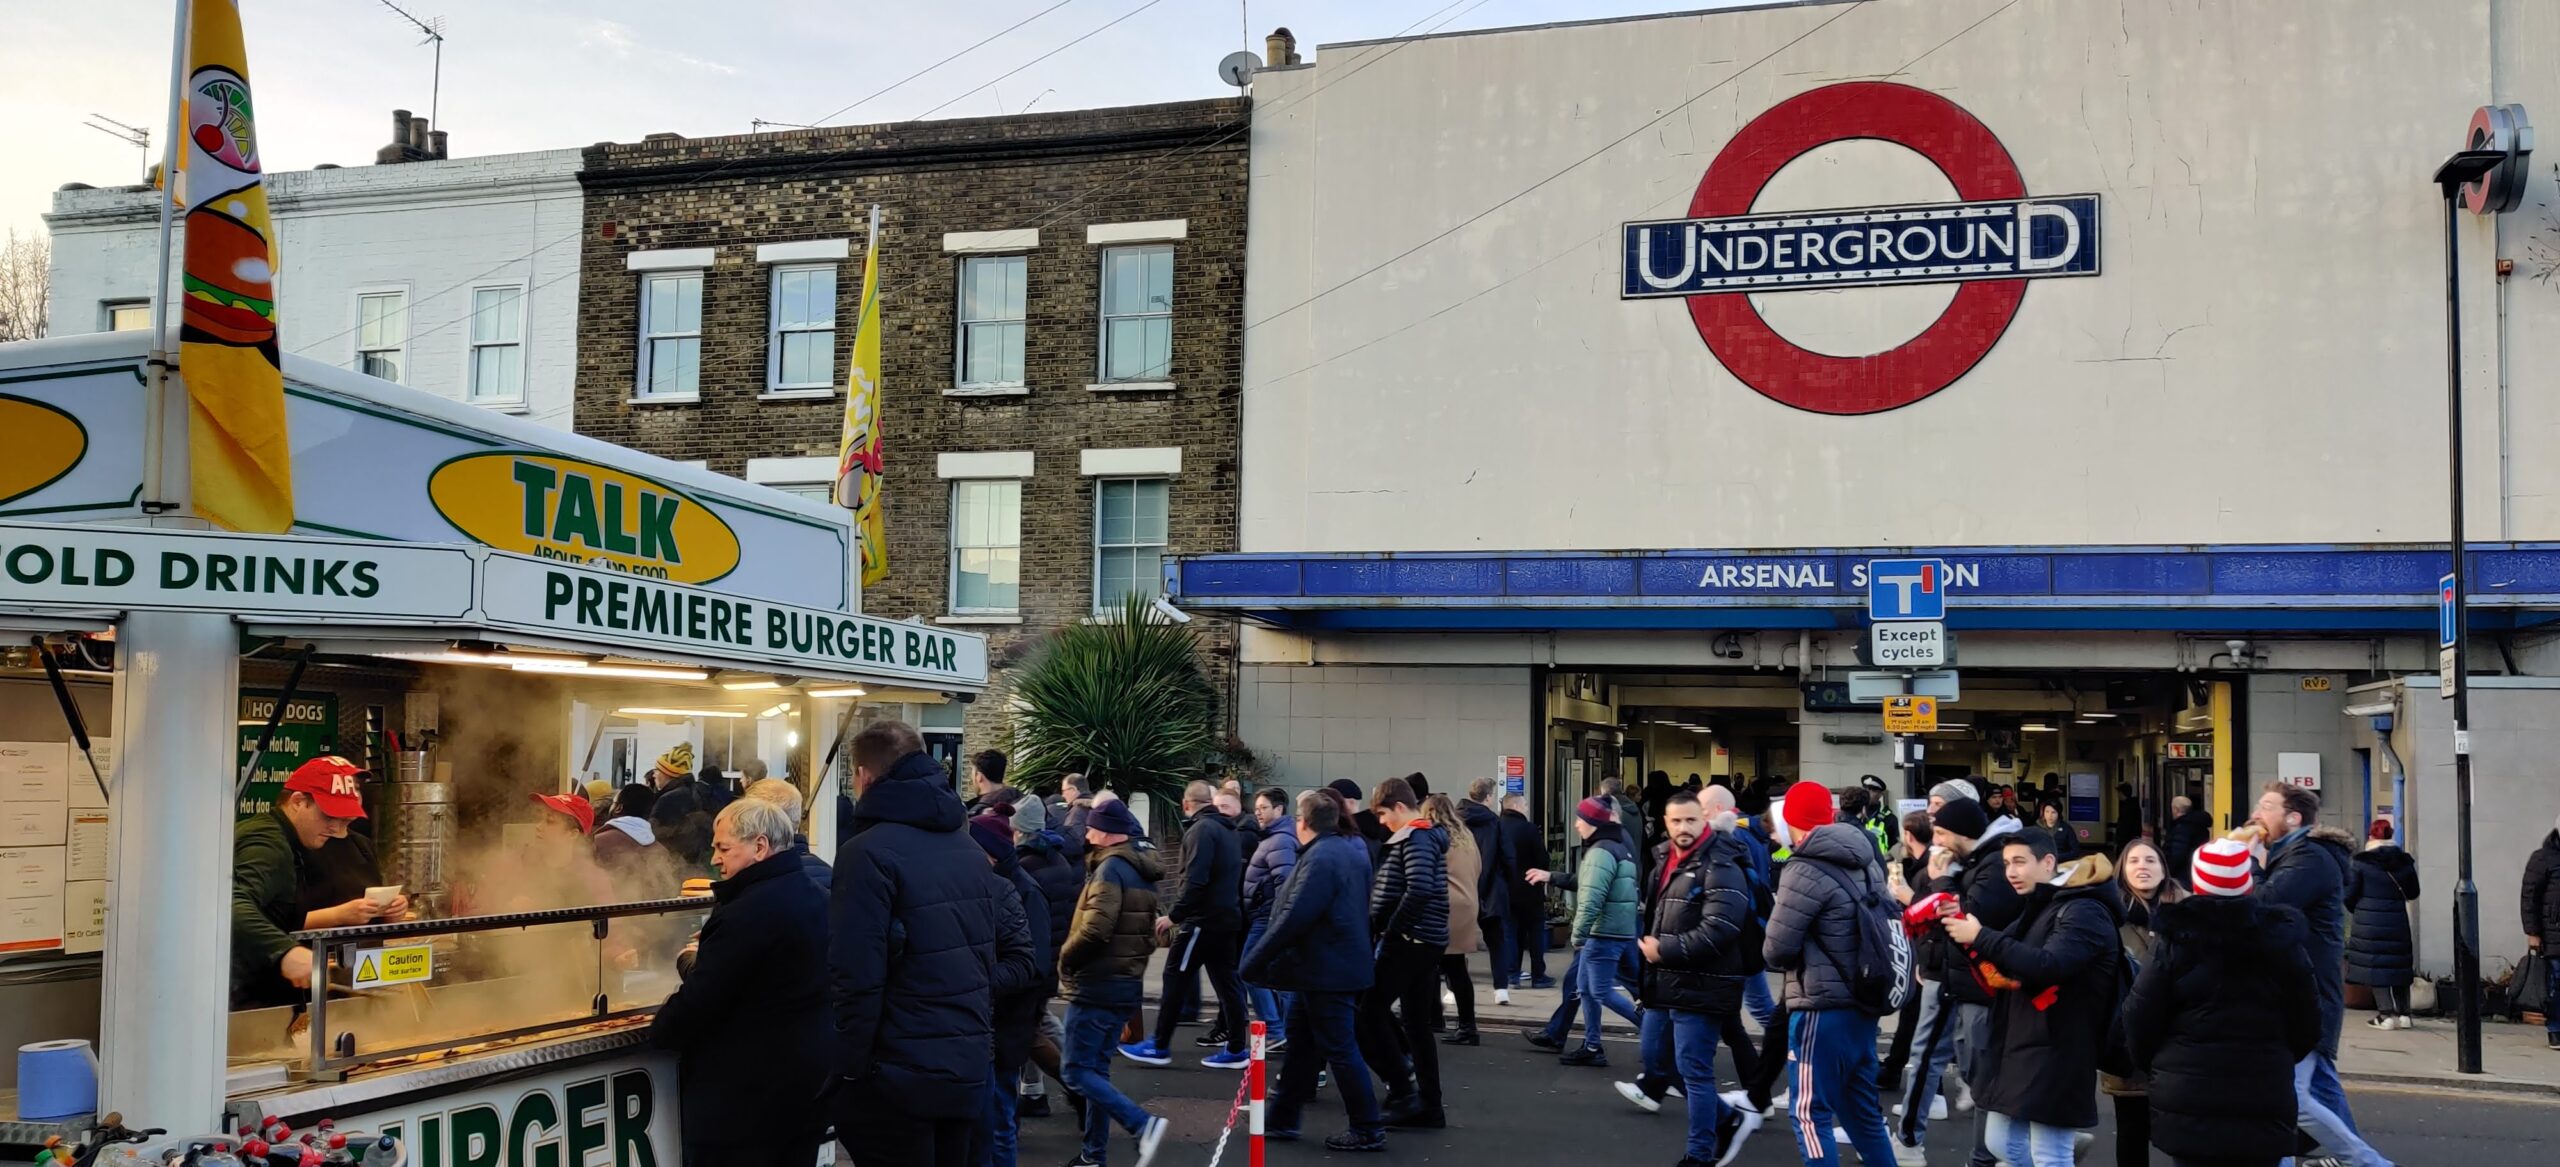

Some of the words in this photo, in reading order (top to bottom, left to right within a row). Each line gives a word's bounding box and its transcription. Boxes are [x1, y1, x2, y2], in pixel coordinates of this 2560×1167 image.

[1639, 203, 2081, 289] UNDERGROUND
[513, 459, 682, 565] TALK
[0, 543, 135, 588] OLD
[160, 551, 380, 598] DRINKS
[1699, 565, 1834, 588] ARSENAL
[545, 571, 753, 646] PREMIERE
[767, 608, 897, 663] BURGER
[905, 633, 957, 672] BAR
[1879, 628, 1937, 643] Except
[1881, 645, 1934, 661] cycles
[2304, 679, 2328, 688] RVP
[252, 702, 279, 718] HO
[286, 704, 323, 721] DOGS
[285, 736, 300, 757] Dog
[240, 798, 255, 813] Hot
[388, 954, 424, 966] Caution
[1887, 918, 1908, 1008] adidas
[345, 1069, 656, 1167] RGER
